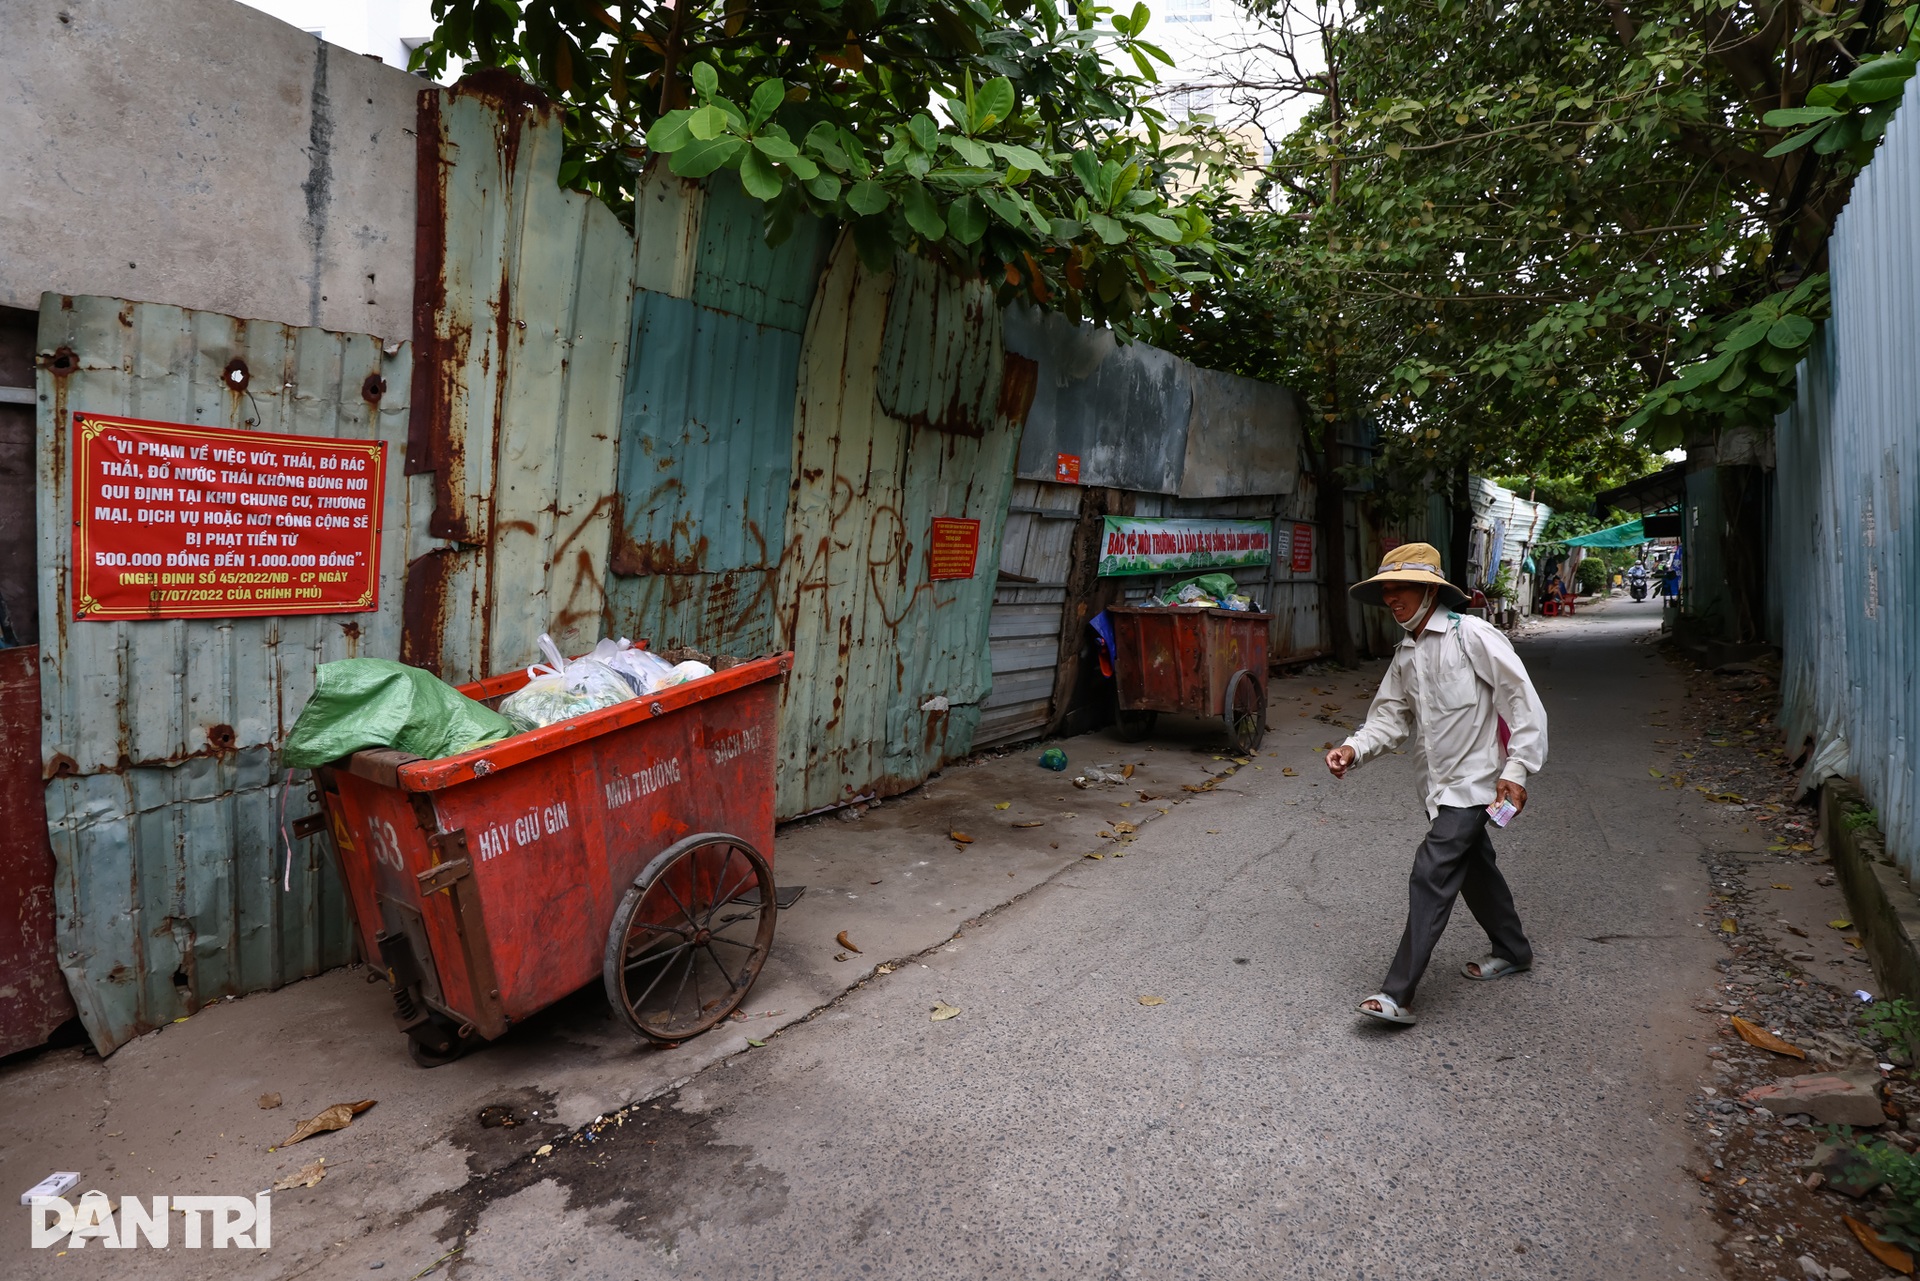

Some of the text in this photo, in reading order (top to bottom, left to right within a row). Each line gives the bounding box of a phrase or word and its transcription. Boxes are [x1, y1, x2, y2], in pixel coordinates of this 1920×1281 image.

[107, 435, 365, 471] “VI PHẠM VỀ VIỆC VỨT, THẢI, BỎ RÁC
[100, 459, 368, 490] THẢI, ĐỔ NƯỚC THẢI KHÔNG ĐÚNG NƠI
[101, 484, 366, 509] QUI ĐỊNH TẠI KHU CHUNG CƯ, THƯƠNG
[95, 506, 368, 530] MẠI, DỊCH VỤ HOẶC NƠI CÔNG CỘNG SẼ
[185, 530, 299, 548] BỊ PHẠT TIỀN TỪ
[95, 549, 365, 567] 500.000 ĐỒNG ĐẾN 1.000.000 ĐỒNG”.
[119, 572, 158, 587] (NGHỊ
[162, 572, 195, 587] ĐỊNH
[198, 569, 216, 584] SỐ
[219, 572, 289, 584] 45/2022/NĐ
[300, 572, 315, 583] CP
[318, 570, 348, 583] NGÀY
[150, 584, 322, 601] 07/07/2022 CỦA CHÍNH PHỦ)
[368, 816, 404, 872] 53
